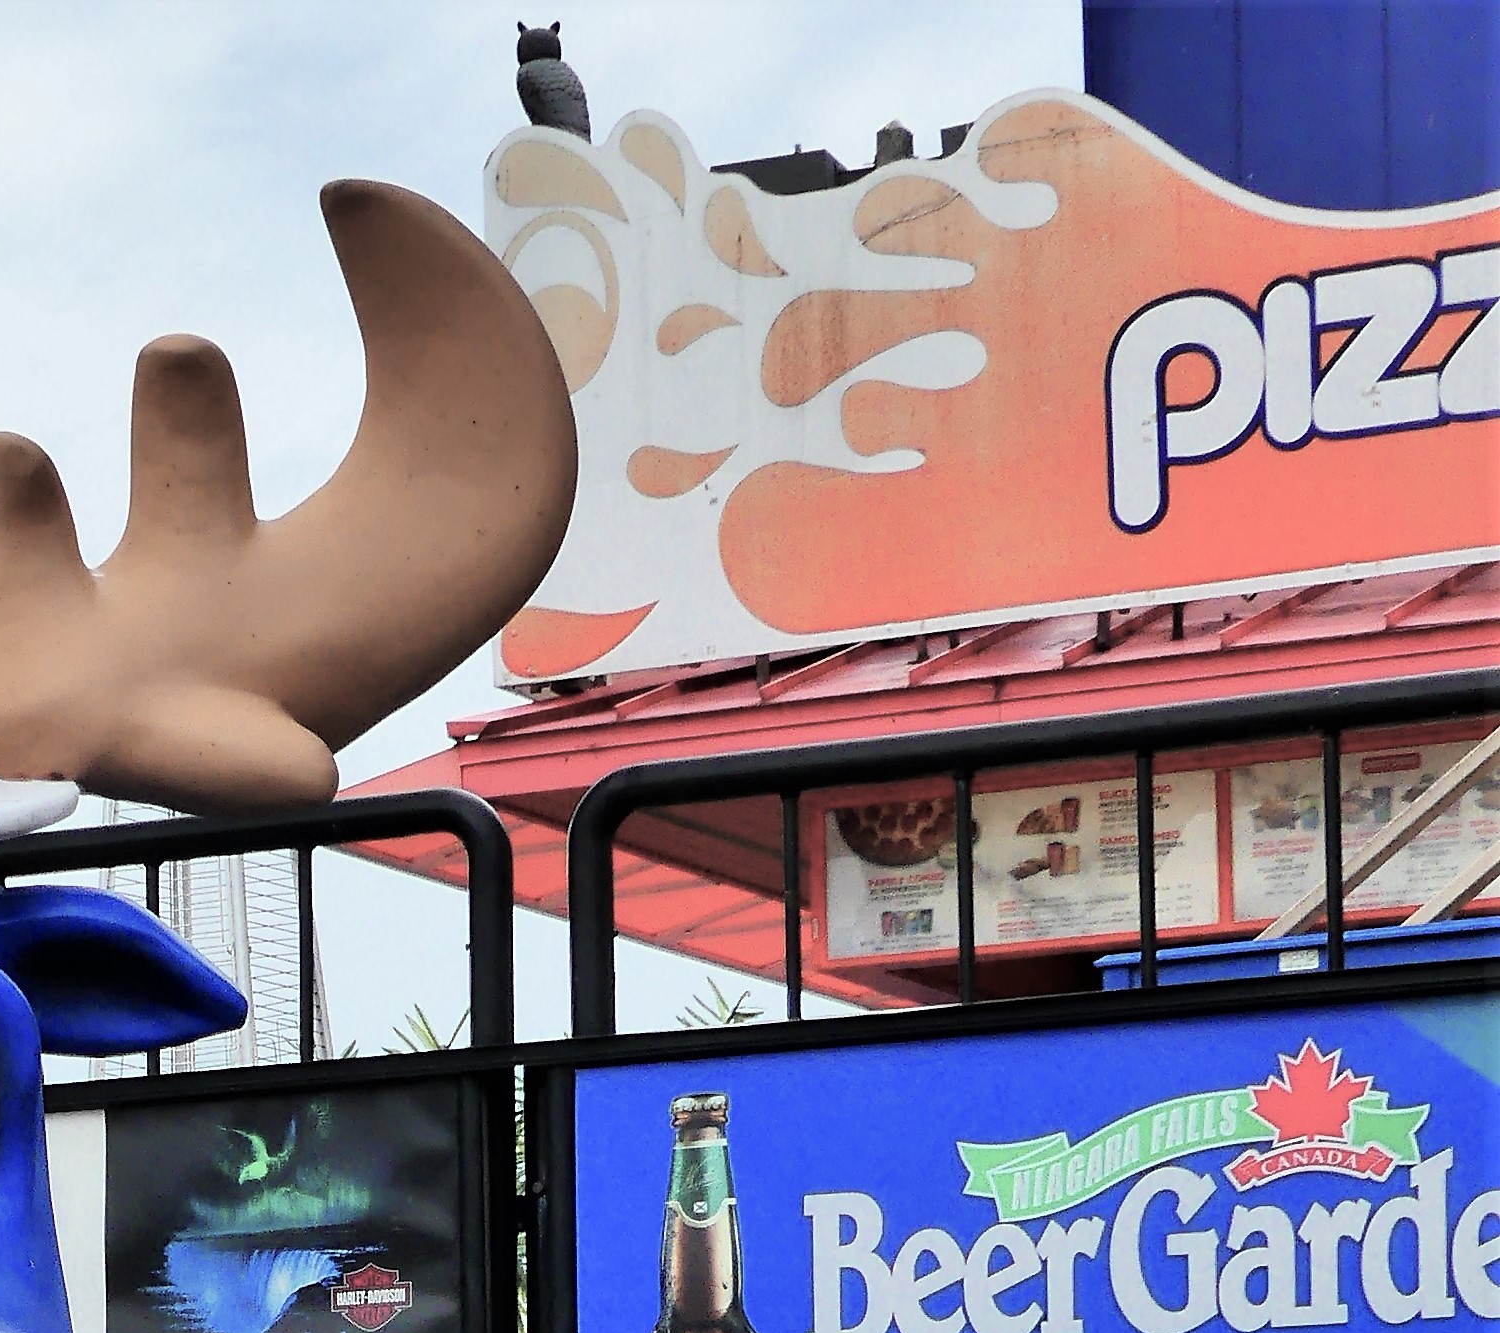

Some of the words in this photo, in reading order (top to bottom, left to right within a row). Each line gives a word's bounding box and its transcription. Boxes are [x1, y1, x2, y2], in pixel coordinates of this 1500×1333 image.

[1011, 1123, 1140, 1211] NIAGARA
[1150, 1097, 1240, 1155] FALLS
[1260, 1147, 1358, 1174] CANADA
